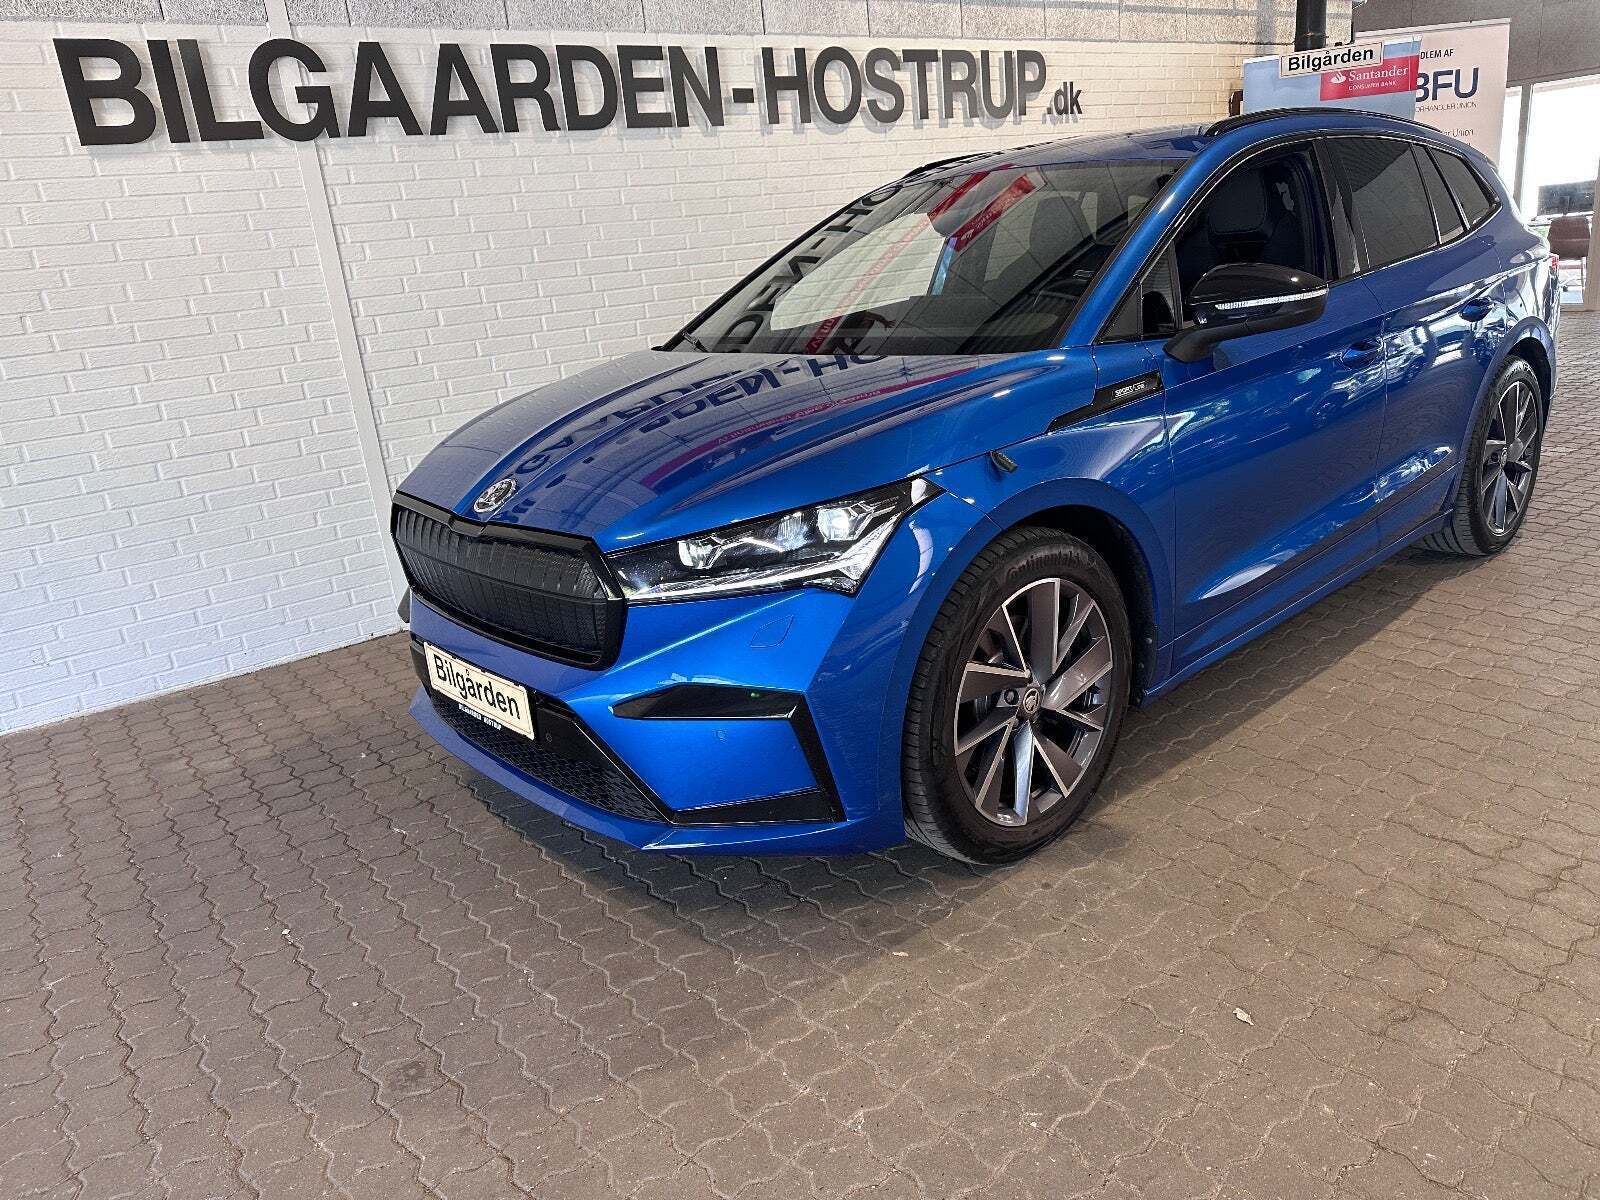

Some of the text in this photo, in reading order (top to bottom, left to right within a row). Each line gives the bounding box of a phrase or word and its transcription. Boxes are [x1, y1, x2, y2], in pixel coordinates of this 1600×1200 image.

[1443, 48, 1454, 58] AF
[1288, 49, 1374, 72] Bilgården
[1348, 65, 1409, 82] Santander
[1380, 80, 1397, 88] BANK
[1452, 128, 1474, 137] Union
[433, 653, 521, 720] Bilgården
